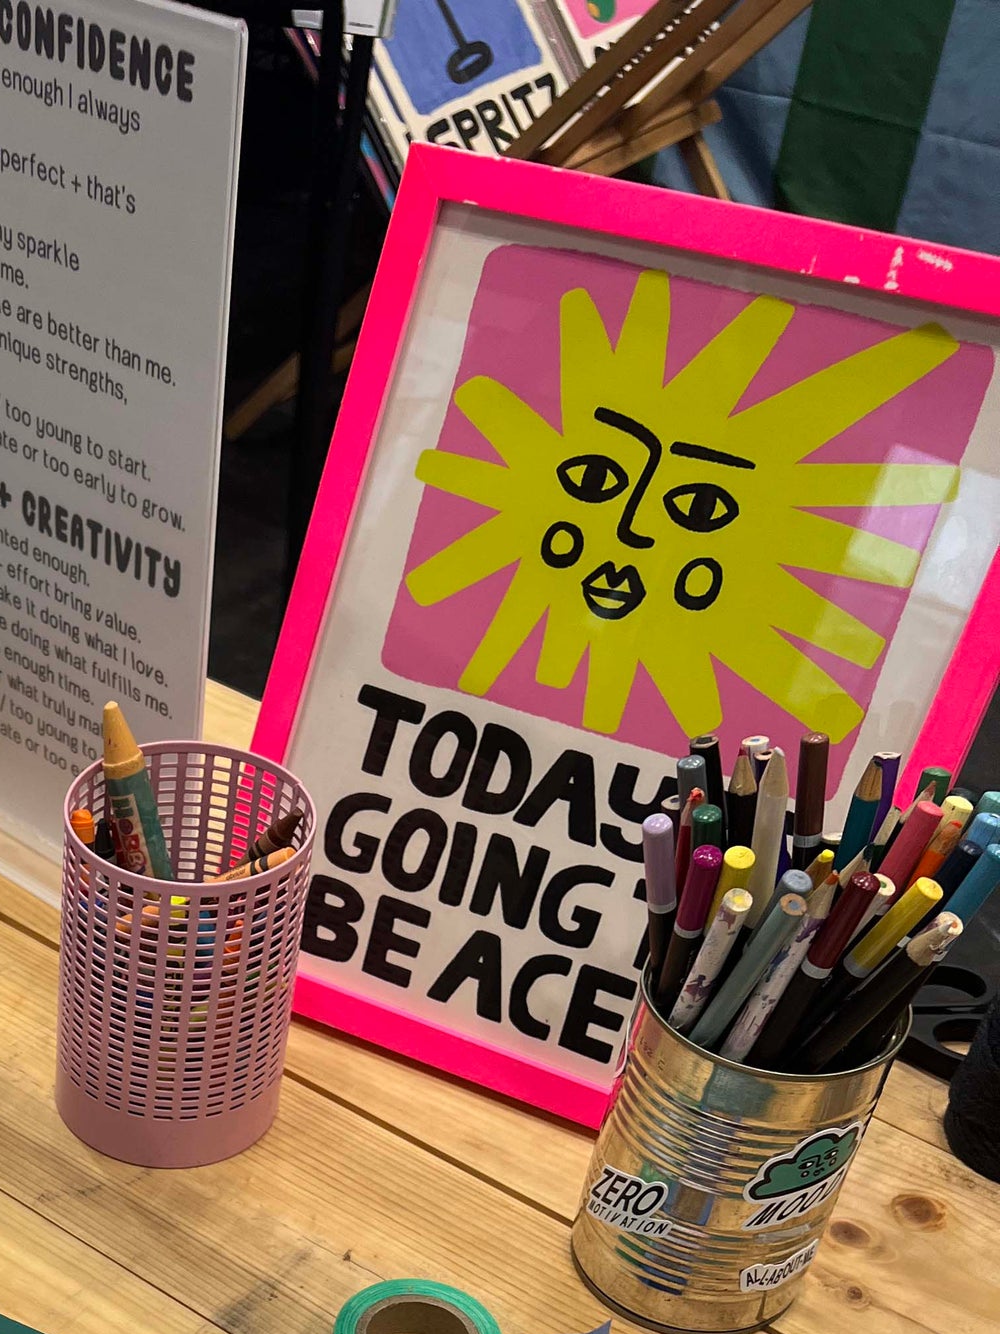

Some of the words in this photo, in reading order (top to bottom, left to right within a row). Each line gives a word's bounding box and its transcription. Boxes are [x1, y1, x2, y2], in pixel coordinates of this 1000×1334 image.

[1, 67, 63, 107] enough
[77, 89, 140, 135] always
[86, 174, 135, 214] that's
[0, 261, 29, 289] me.
[16, 231, 79, 271] sparkle
[15, 305, 43, 330] are
[47, 311, 99, 352] better
[104, 337, 141, 371] than
[144, 358, 176, 386] me.
[45, 352, 127, 404] strengths,
[4, 398, 31, 427] too
[35, 416, 82, 454] young
[86, 435, 103, 460] to
[107, 448, 150, 482] start.
[21, 443, 39, 462] or
[42, 448, 69, 477] too
[73, 467, 116, 503] early
[120, 484, 137, 508] to
[141, 498, 185, 532] grow.
[21, 490, 181, 597] CREATIVITY
[358, 684, 679, 863] TODAY
[324, 793, 615, 949] GOING
[300, 875, 431, 988] BE
[427, 930, 638, 1064] ACE
[588, 1202, 667, 1235] MOTIVATION
[591, 1168, 664, 1214] ZERO
[746, 1168, 844, 1227] MOOD
